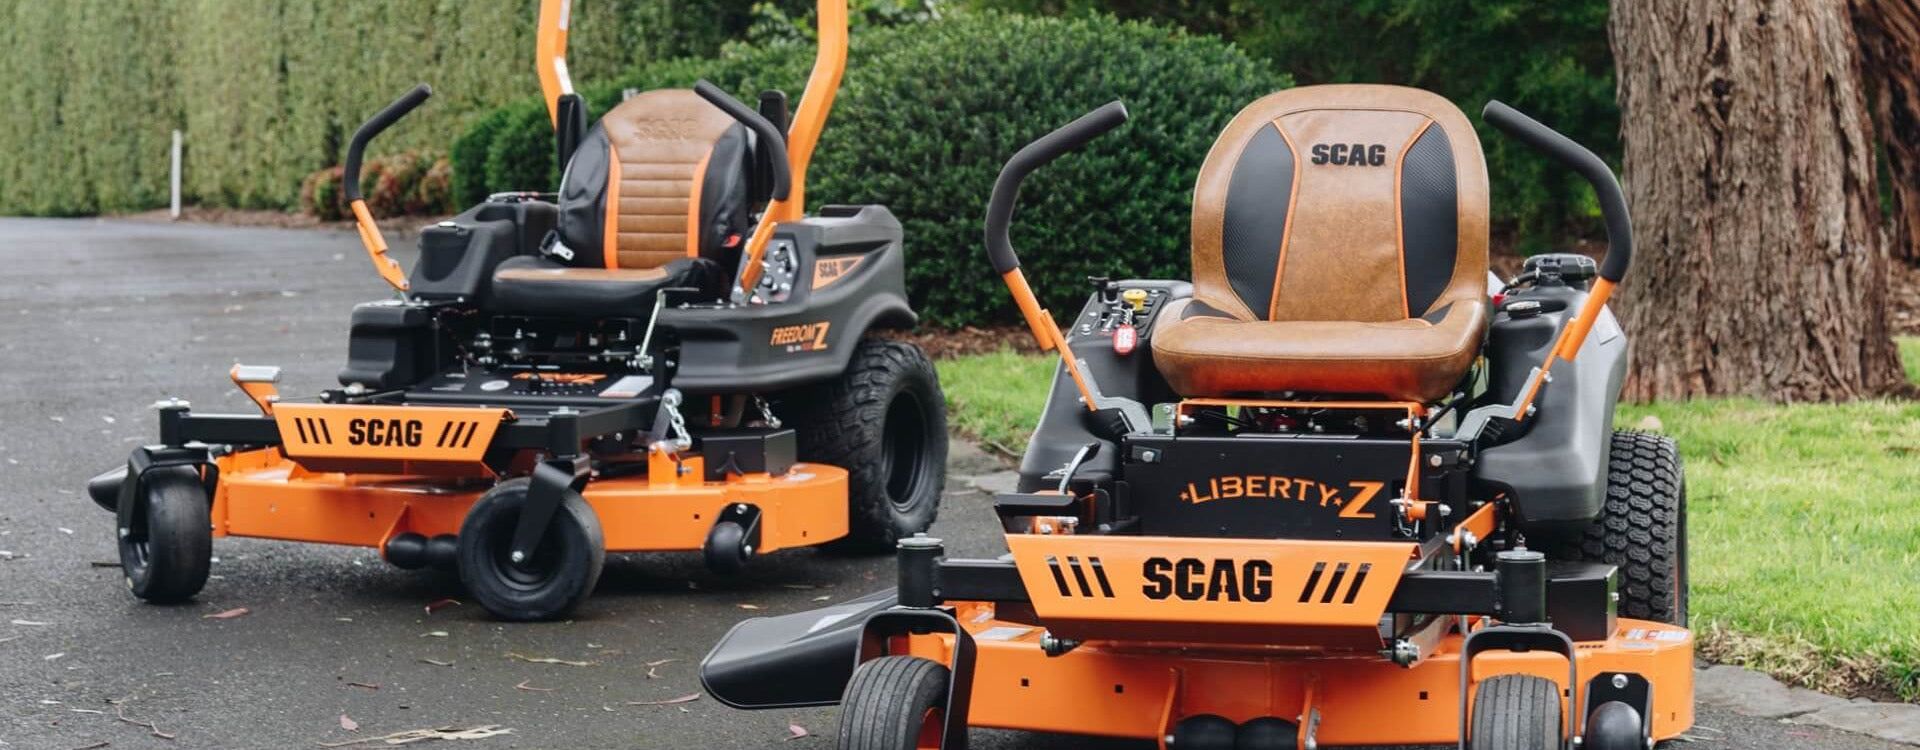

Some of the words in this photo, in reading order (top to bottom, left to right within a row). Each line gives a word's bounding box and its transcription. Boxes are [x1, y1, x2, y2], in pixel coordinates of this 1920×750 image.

[1311, 143, 1386, 166] SCAG
[348, 418, 423, 447] SCAG
[1188, 475, 1339, 508] LIBERTY
[1338, 481, 1385, 518] Z
[1142, 557, 1273, 603] SCAG
